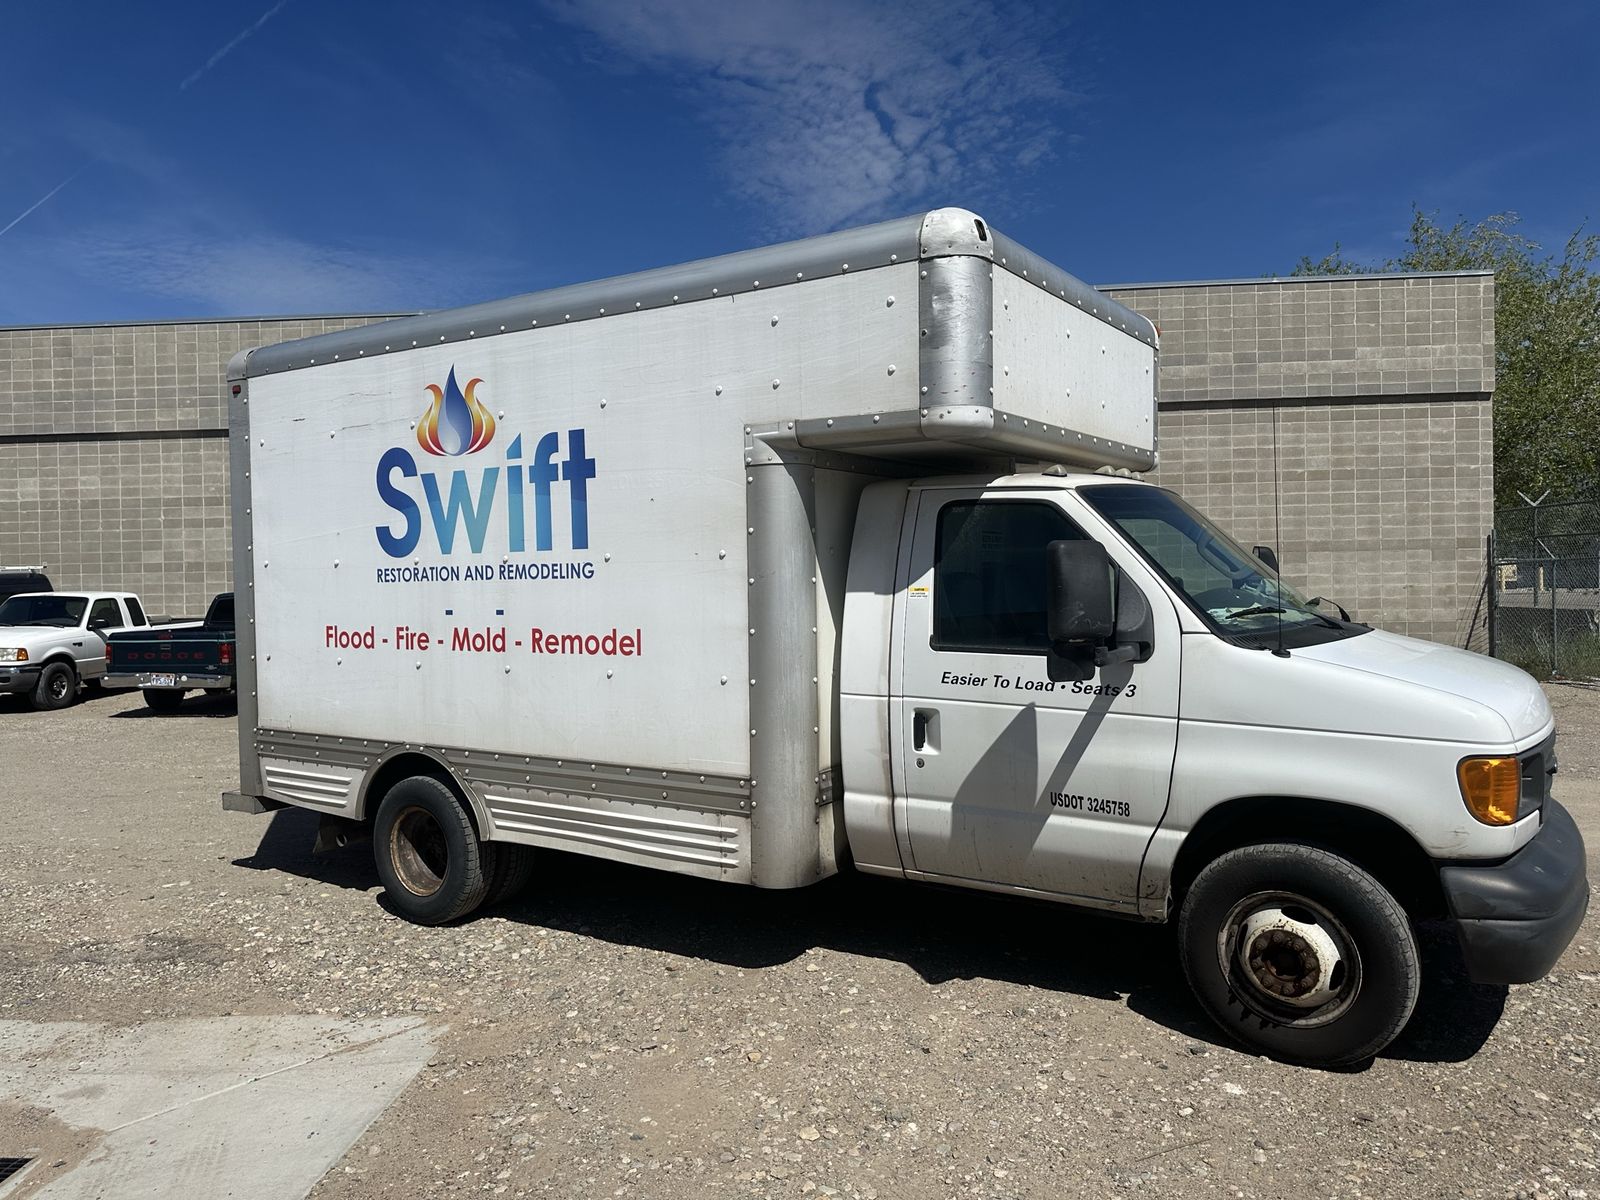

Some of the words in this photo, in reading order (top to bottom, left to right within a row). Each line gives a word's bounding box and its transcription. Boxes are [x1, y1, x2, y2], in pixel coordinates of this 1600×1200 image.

[375, 428, 596, 558] Swift
[376, 566, 460, 583] RESTORATION
[464, 565, 494, 581] AND
[499, 562, 594, 580] REMODELING
[325, 626, 375, 649] Flood
[396, 626, 430, 651] Fire
[452, 627, 506, 652] Mold
[531, 628, 642, 656] Remodel
[941, 671, 988, 687] Easier
[993, 674, 1010, 689] To
[1071, 680, 1120, 697] Seats
[1125, 684, 1137, 698] 3
[1050, 791, 1084, 810] USDOT
[1087, 797, 1130, 817] 3245758
